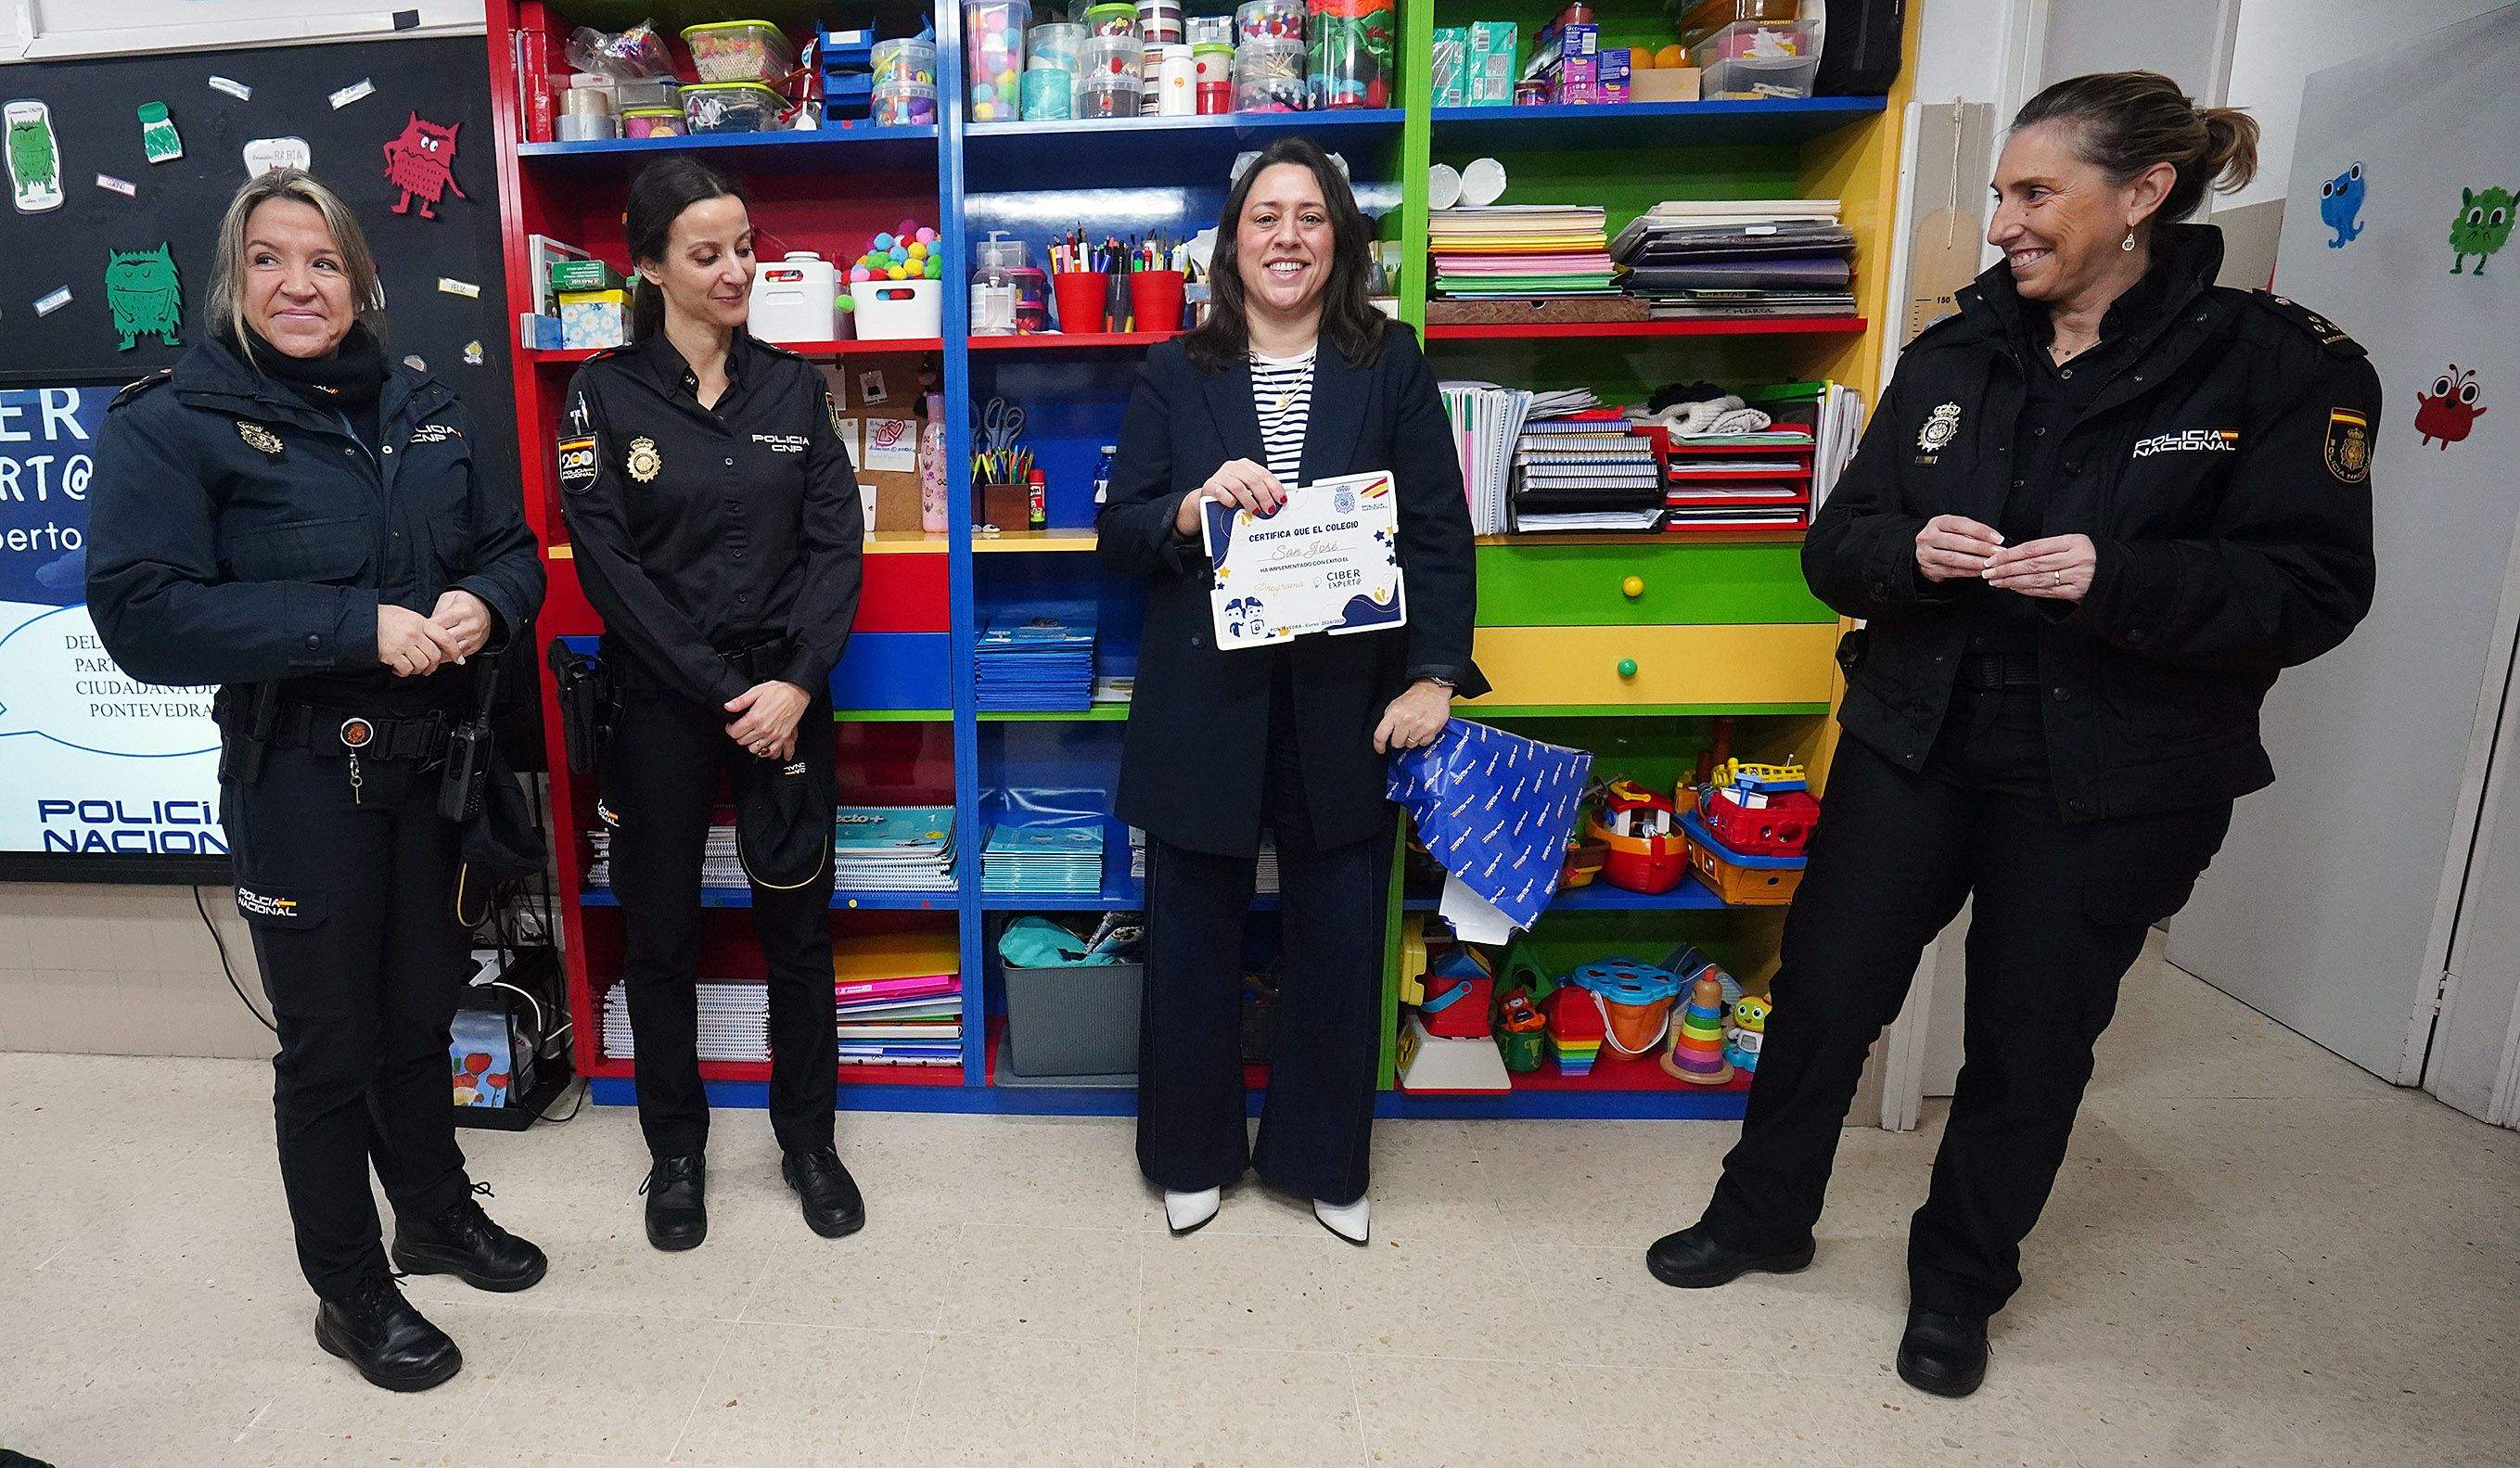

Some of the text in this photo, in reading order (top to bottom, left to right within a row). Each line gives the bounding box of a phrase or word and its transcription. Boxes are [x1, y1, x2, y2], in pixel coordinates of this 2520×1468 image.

[1937, 295, 1951, 304] 150
[410, 433, 446, 442] CNP
[752, 434, 810, 445] POLICIA
[2135, 429, 2221, 451] POLICIA
[772, 444, 803, 453] CNP
[2133, 440, 2235, 458] NACIONAL
[2328, 439, 2345, 477] POLICIA
[0, 521, 83, 552] erto
[1248, 530, 1291, 543] CERTIFICA
[1294, 527, 1310, 536] QUE
[1325, 520, 1359, 532] COLEGIO
[1272, 540, 1338, 561] San José
[1269, 561, 1312, 572] IMPLEMENTADO
[1326, 568, 1361, 581] CIBER
[1328, 578, 1362, 590] EXPERT@
[89, 703, 213, 718] PONTEVEDRA
[238, 887, 281, 908] POLICIA
[237, 897, 298, 916] NACIONAL
